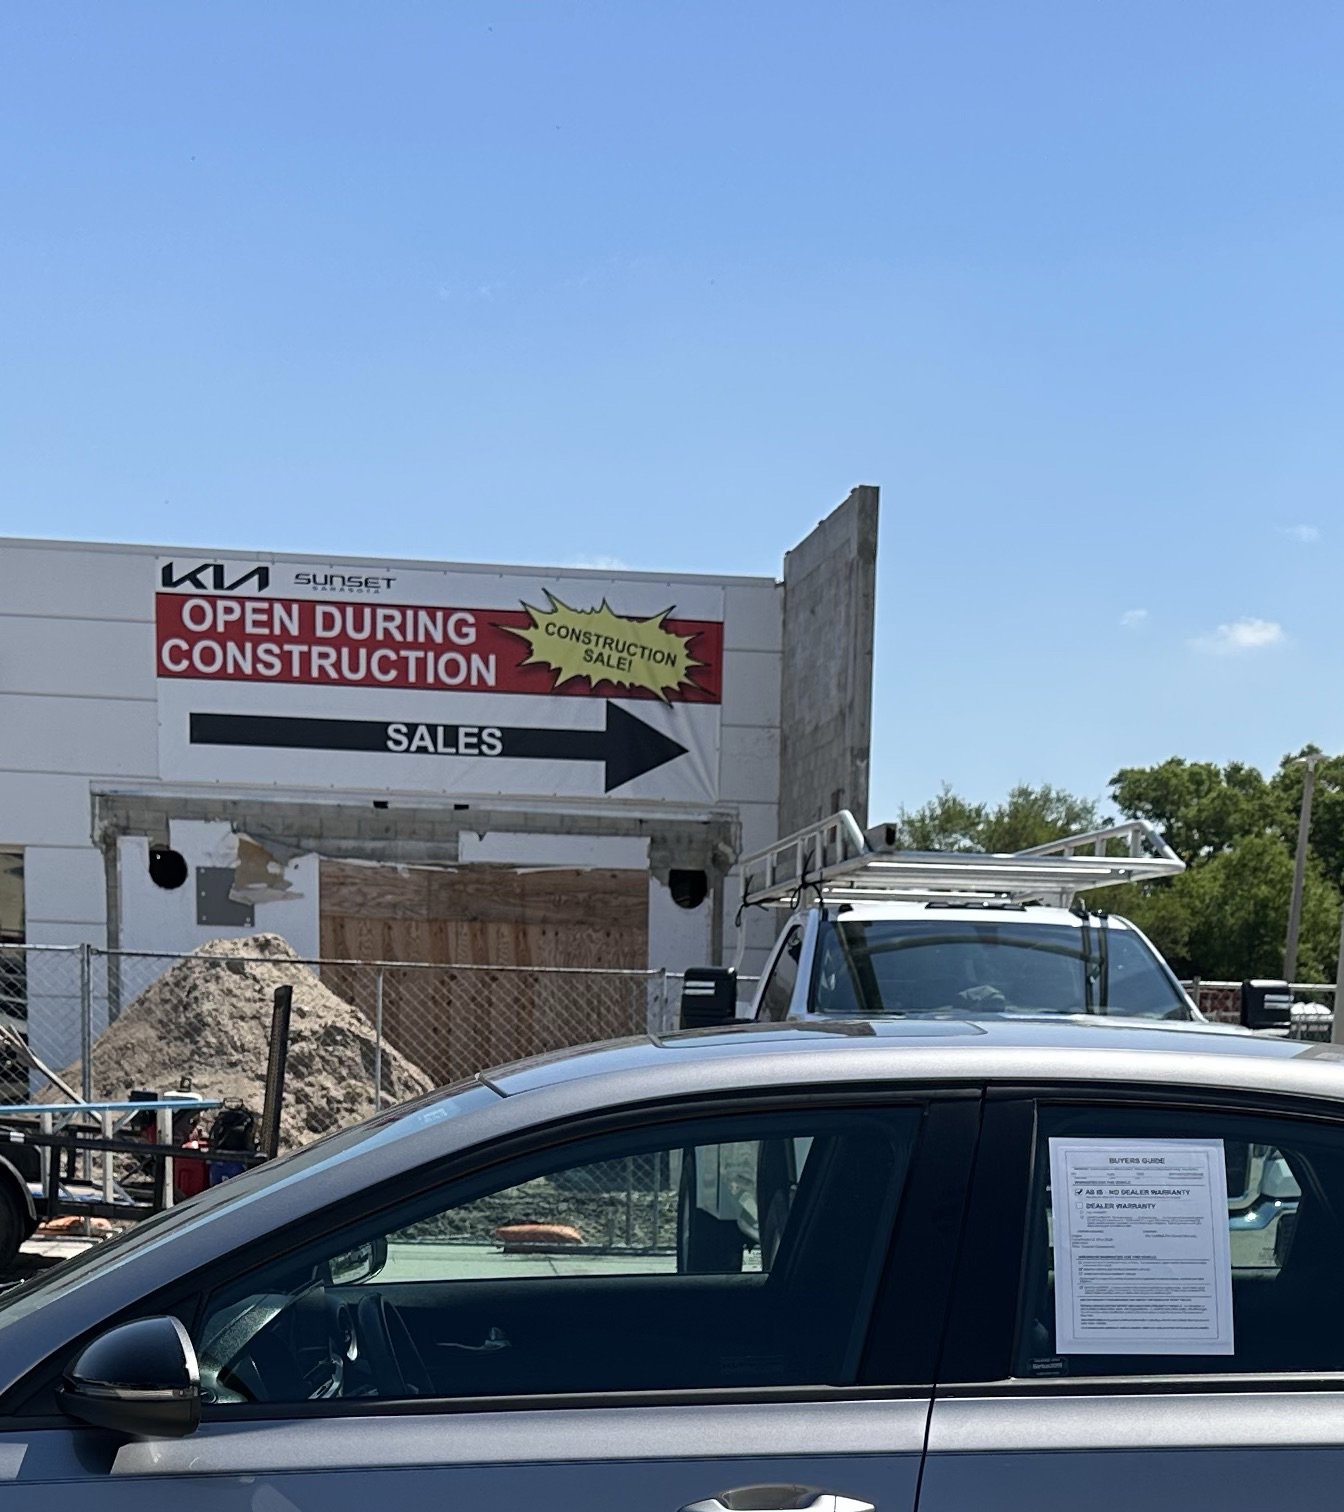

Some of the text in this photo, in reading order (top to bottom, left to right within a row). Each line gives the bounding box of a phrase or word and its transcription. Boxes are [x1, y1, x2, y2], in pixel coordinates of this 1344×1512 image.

[293, 572, 397, 590] SUNSET
[182, 598, 476, 645] OPEN DURING
[161, 638, 497, 687] CONSTRUCTION
[544, 621, 678, 669] CONSTRUCTION
[582, 647, 634, 674] SALE!
[387, 723, 503, 756] SALES
